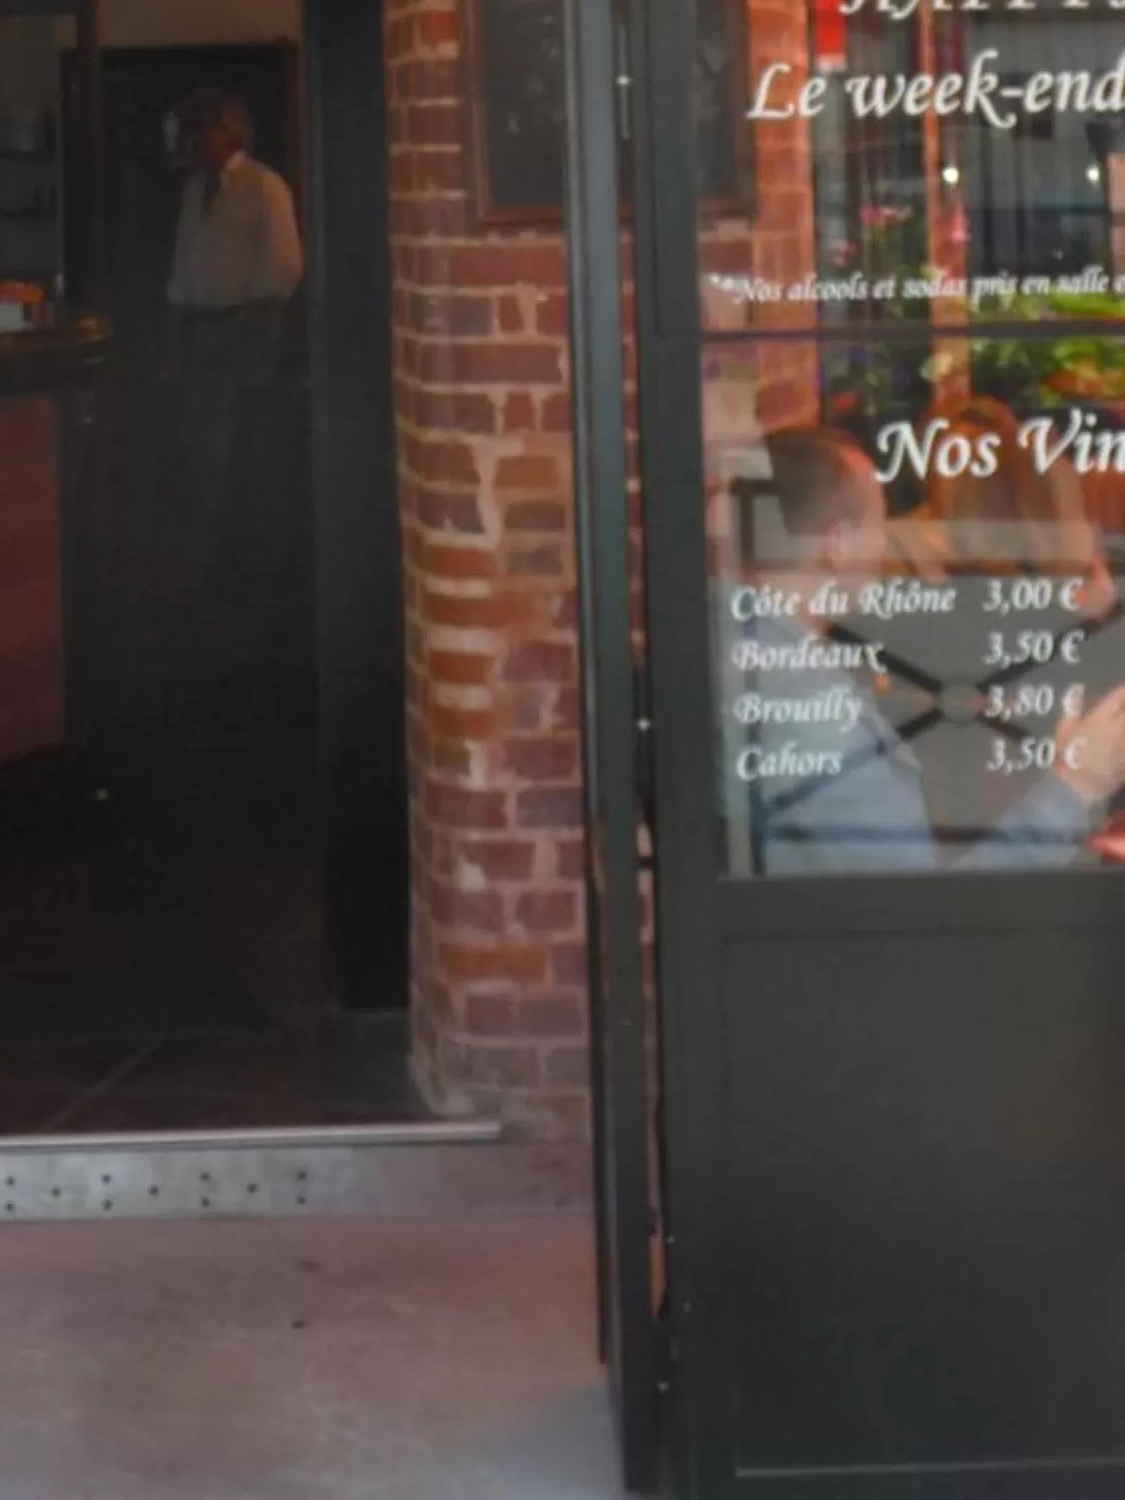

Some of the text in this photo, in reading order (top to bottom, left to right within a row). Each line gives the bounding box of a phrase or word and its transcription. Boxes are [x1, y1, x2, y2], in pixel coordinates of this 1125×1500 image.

[747, 62, 826, 120] Le
[876, 418, 1000, 481] Nos
[809, 579, 851, 616] du
[859, 576, 958, 619] Rhône
[982, 577, 1053, 616] 3,00
[732, 636, 888, 674] Bordeaux
[983, 630, 1056, 666] 3,50
[733, 685, 863, 733] Brouilly
[984, 684, 1055, 720] 3,80
[735, 741, 844, 782] Cahors
[986, 738, 1057, 774] 3,50
